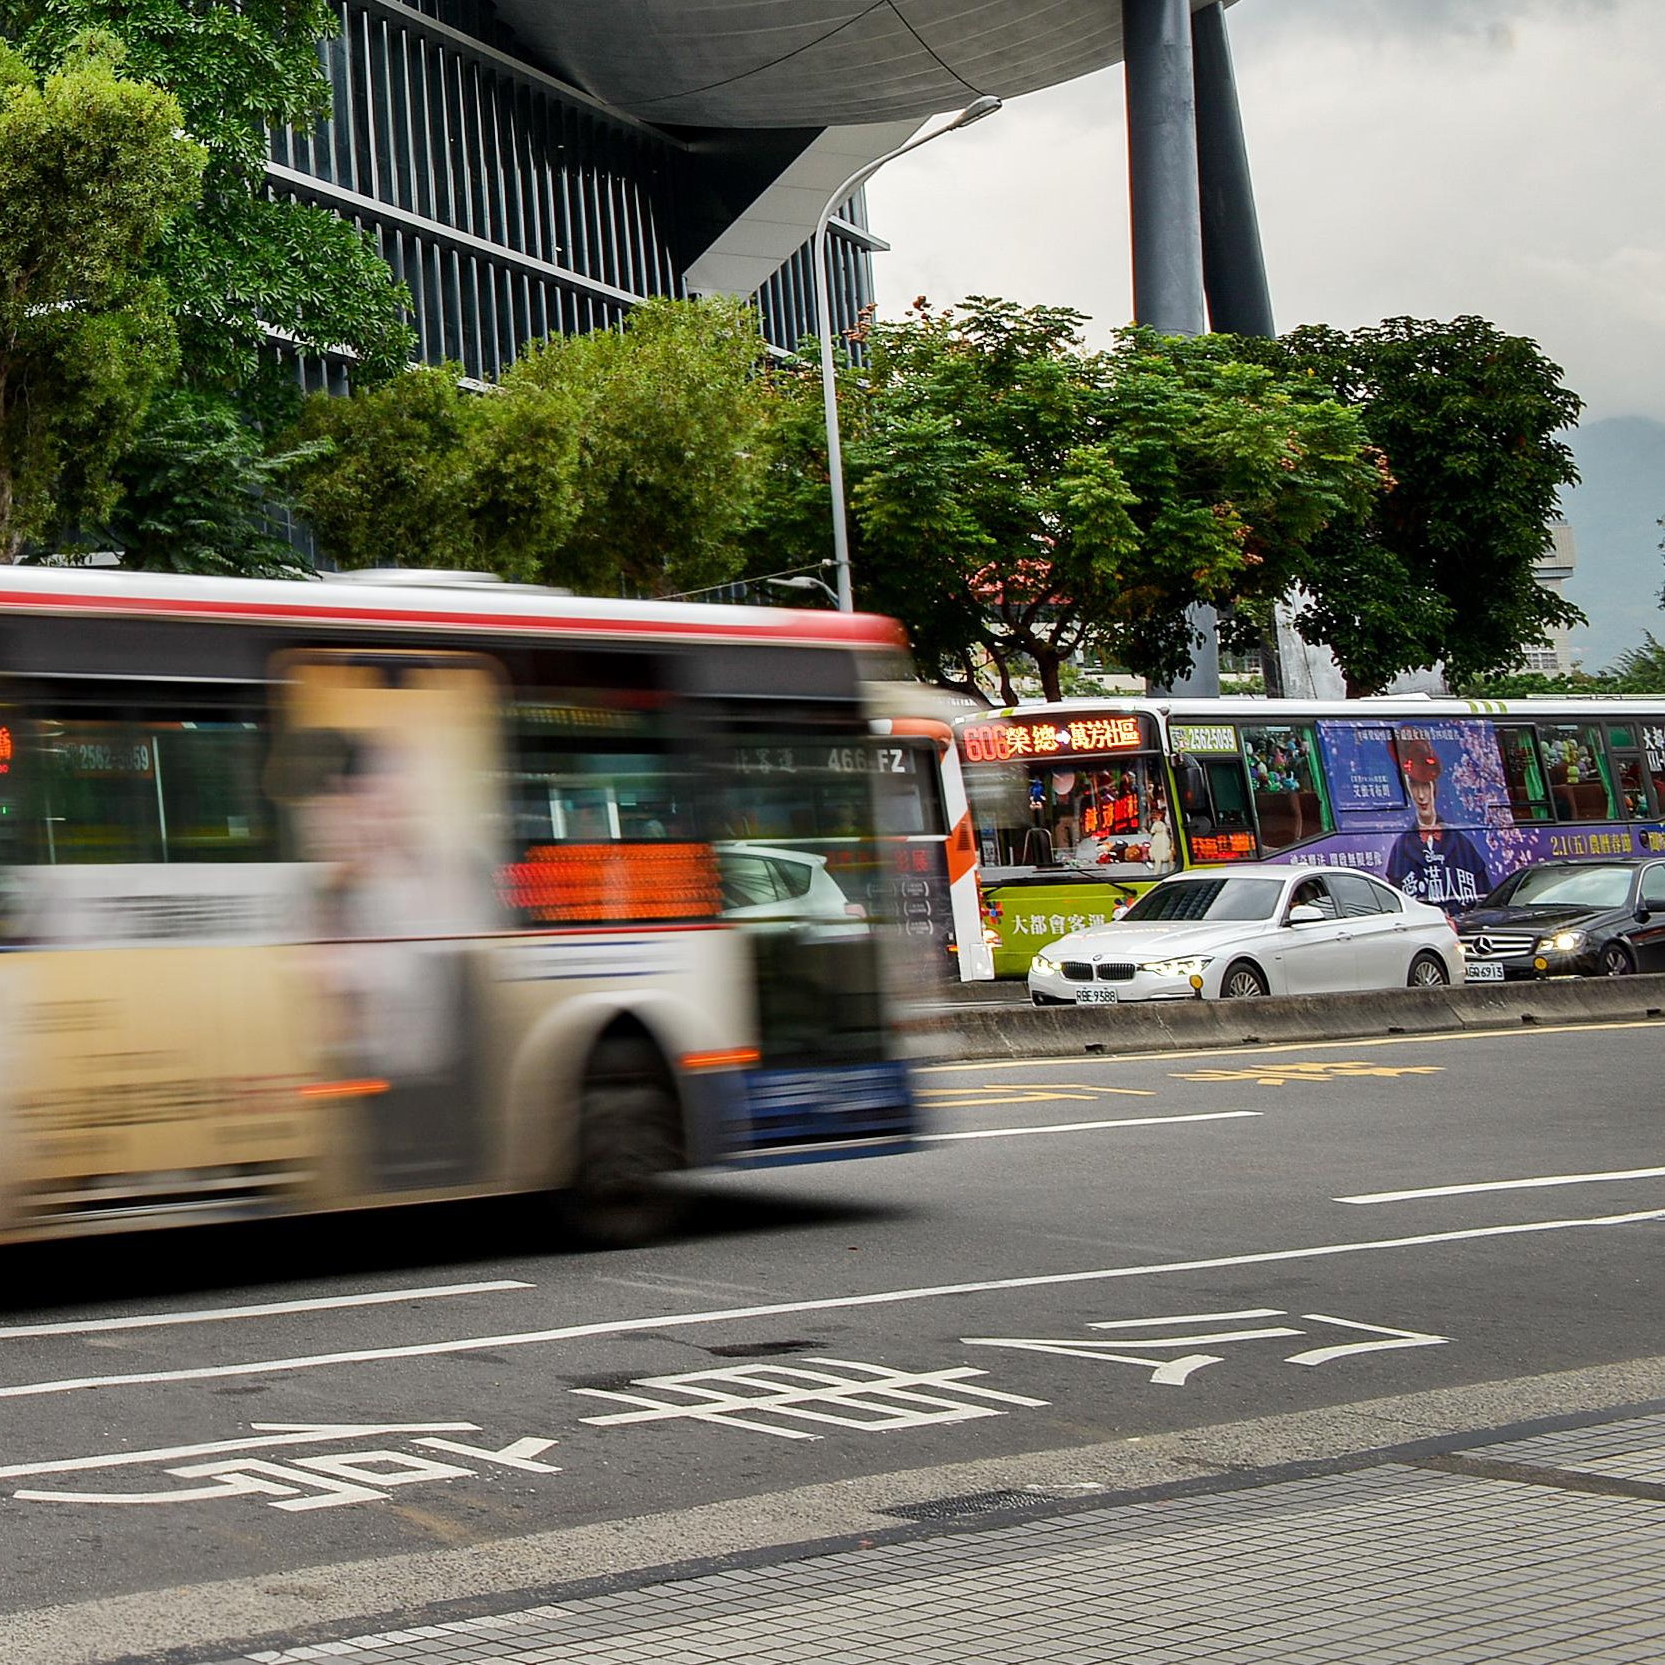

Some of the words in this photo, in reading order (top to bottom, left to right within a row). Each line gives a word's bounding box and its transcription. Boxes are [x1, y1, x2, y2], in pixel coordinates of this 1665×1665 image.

[963, 724, 1010, 762] 606
[1006, 724, 1060, 754] 榮總
[1070, 717, 1141, 751] 萬芳社區
